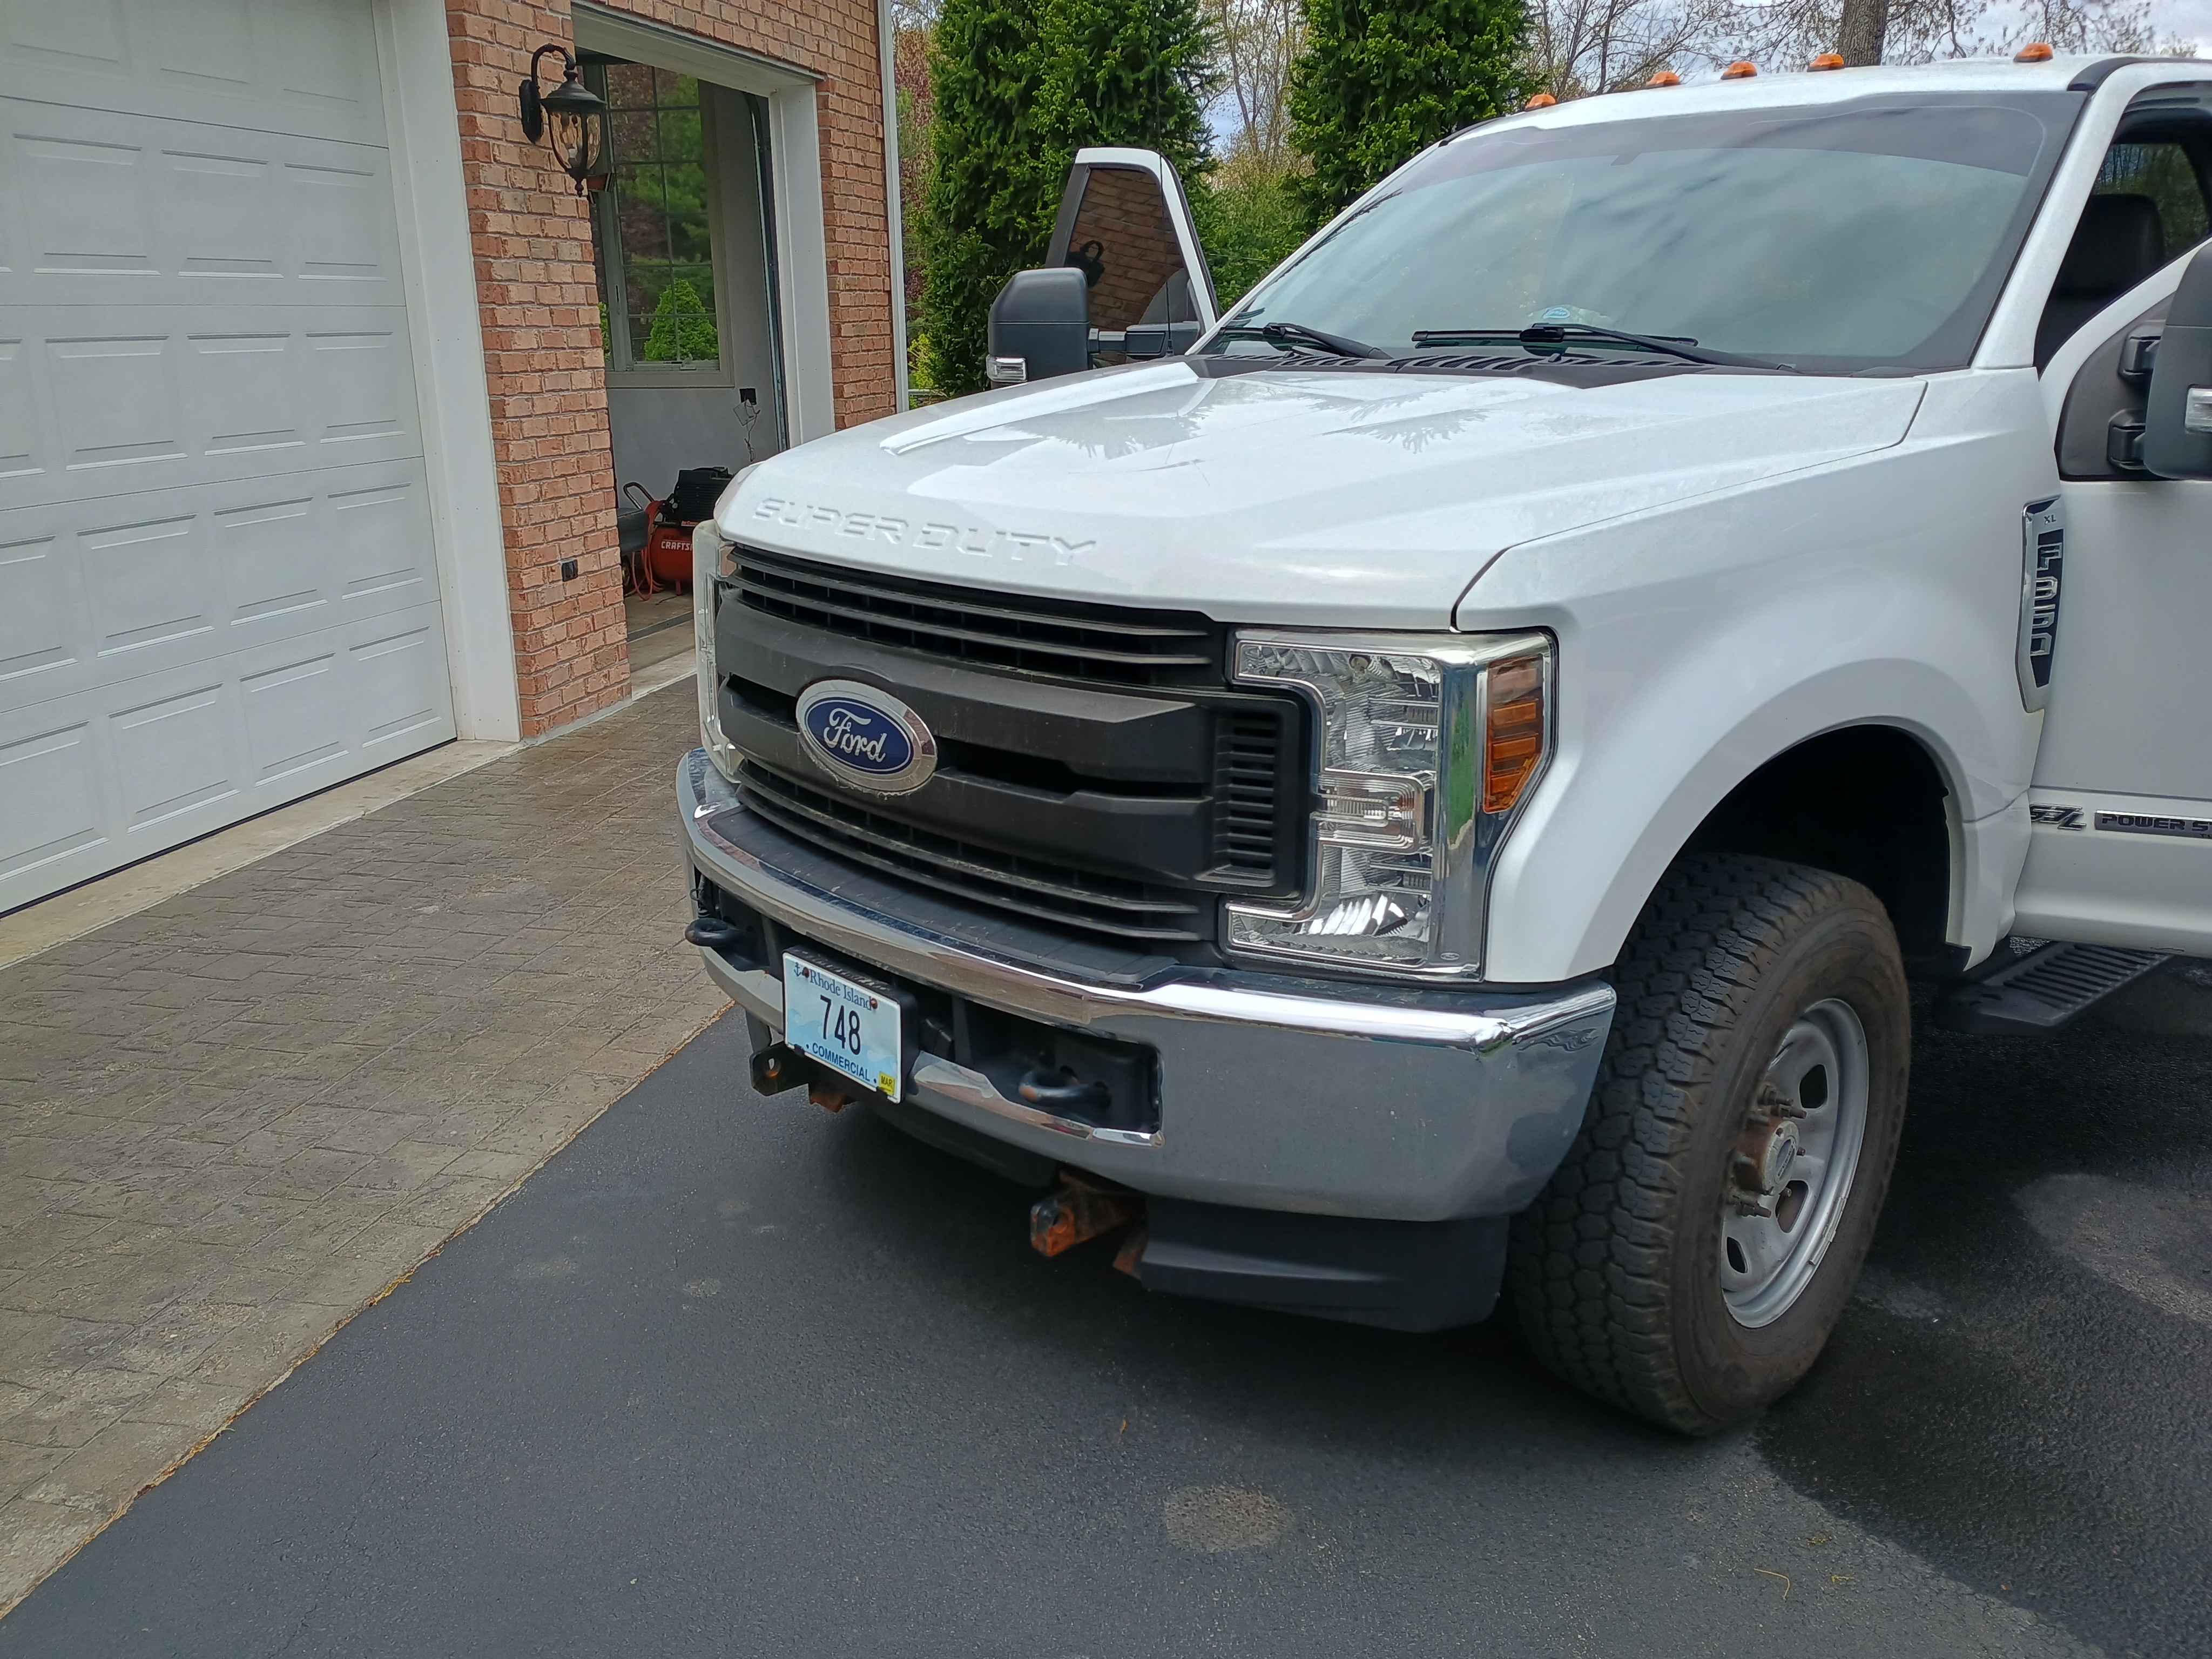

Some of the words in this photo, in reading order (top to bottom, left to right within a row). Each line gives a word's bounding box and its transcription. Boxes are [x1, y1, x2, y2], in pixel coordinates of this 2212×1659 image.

[752, 497, 909, 544] SUPER
[913, 522, 1097, 567] DUTY
[2044, 515, 2057, 524] XL
[823, 707, 888, 763] Ford
[2101, 813, 2186, 831] POWER
[809, 969, 841, 996] Rhode
[842, 984, 872, 1011] Island
[820, 994, 861, 1055] 748
[812, 1042, 871, 1082] COMMERCIAL
[881, 1075, 893, 1088] MAR
